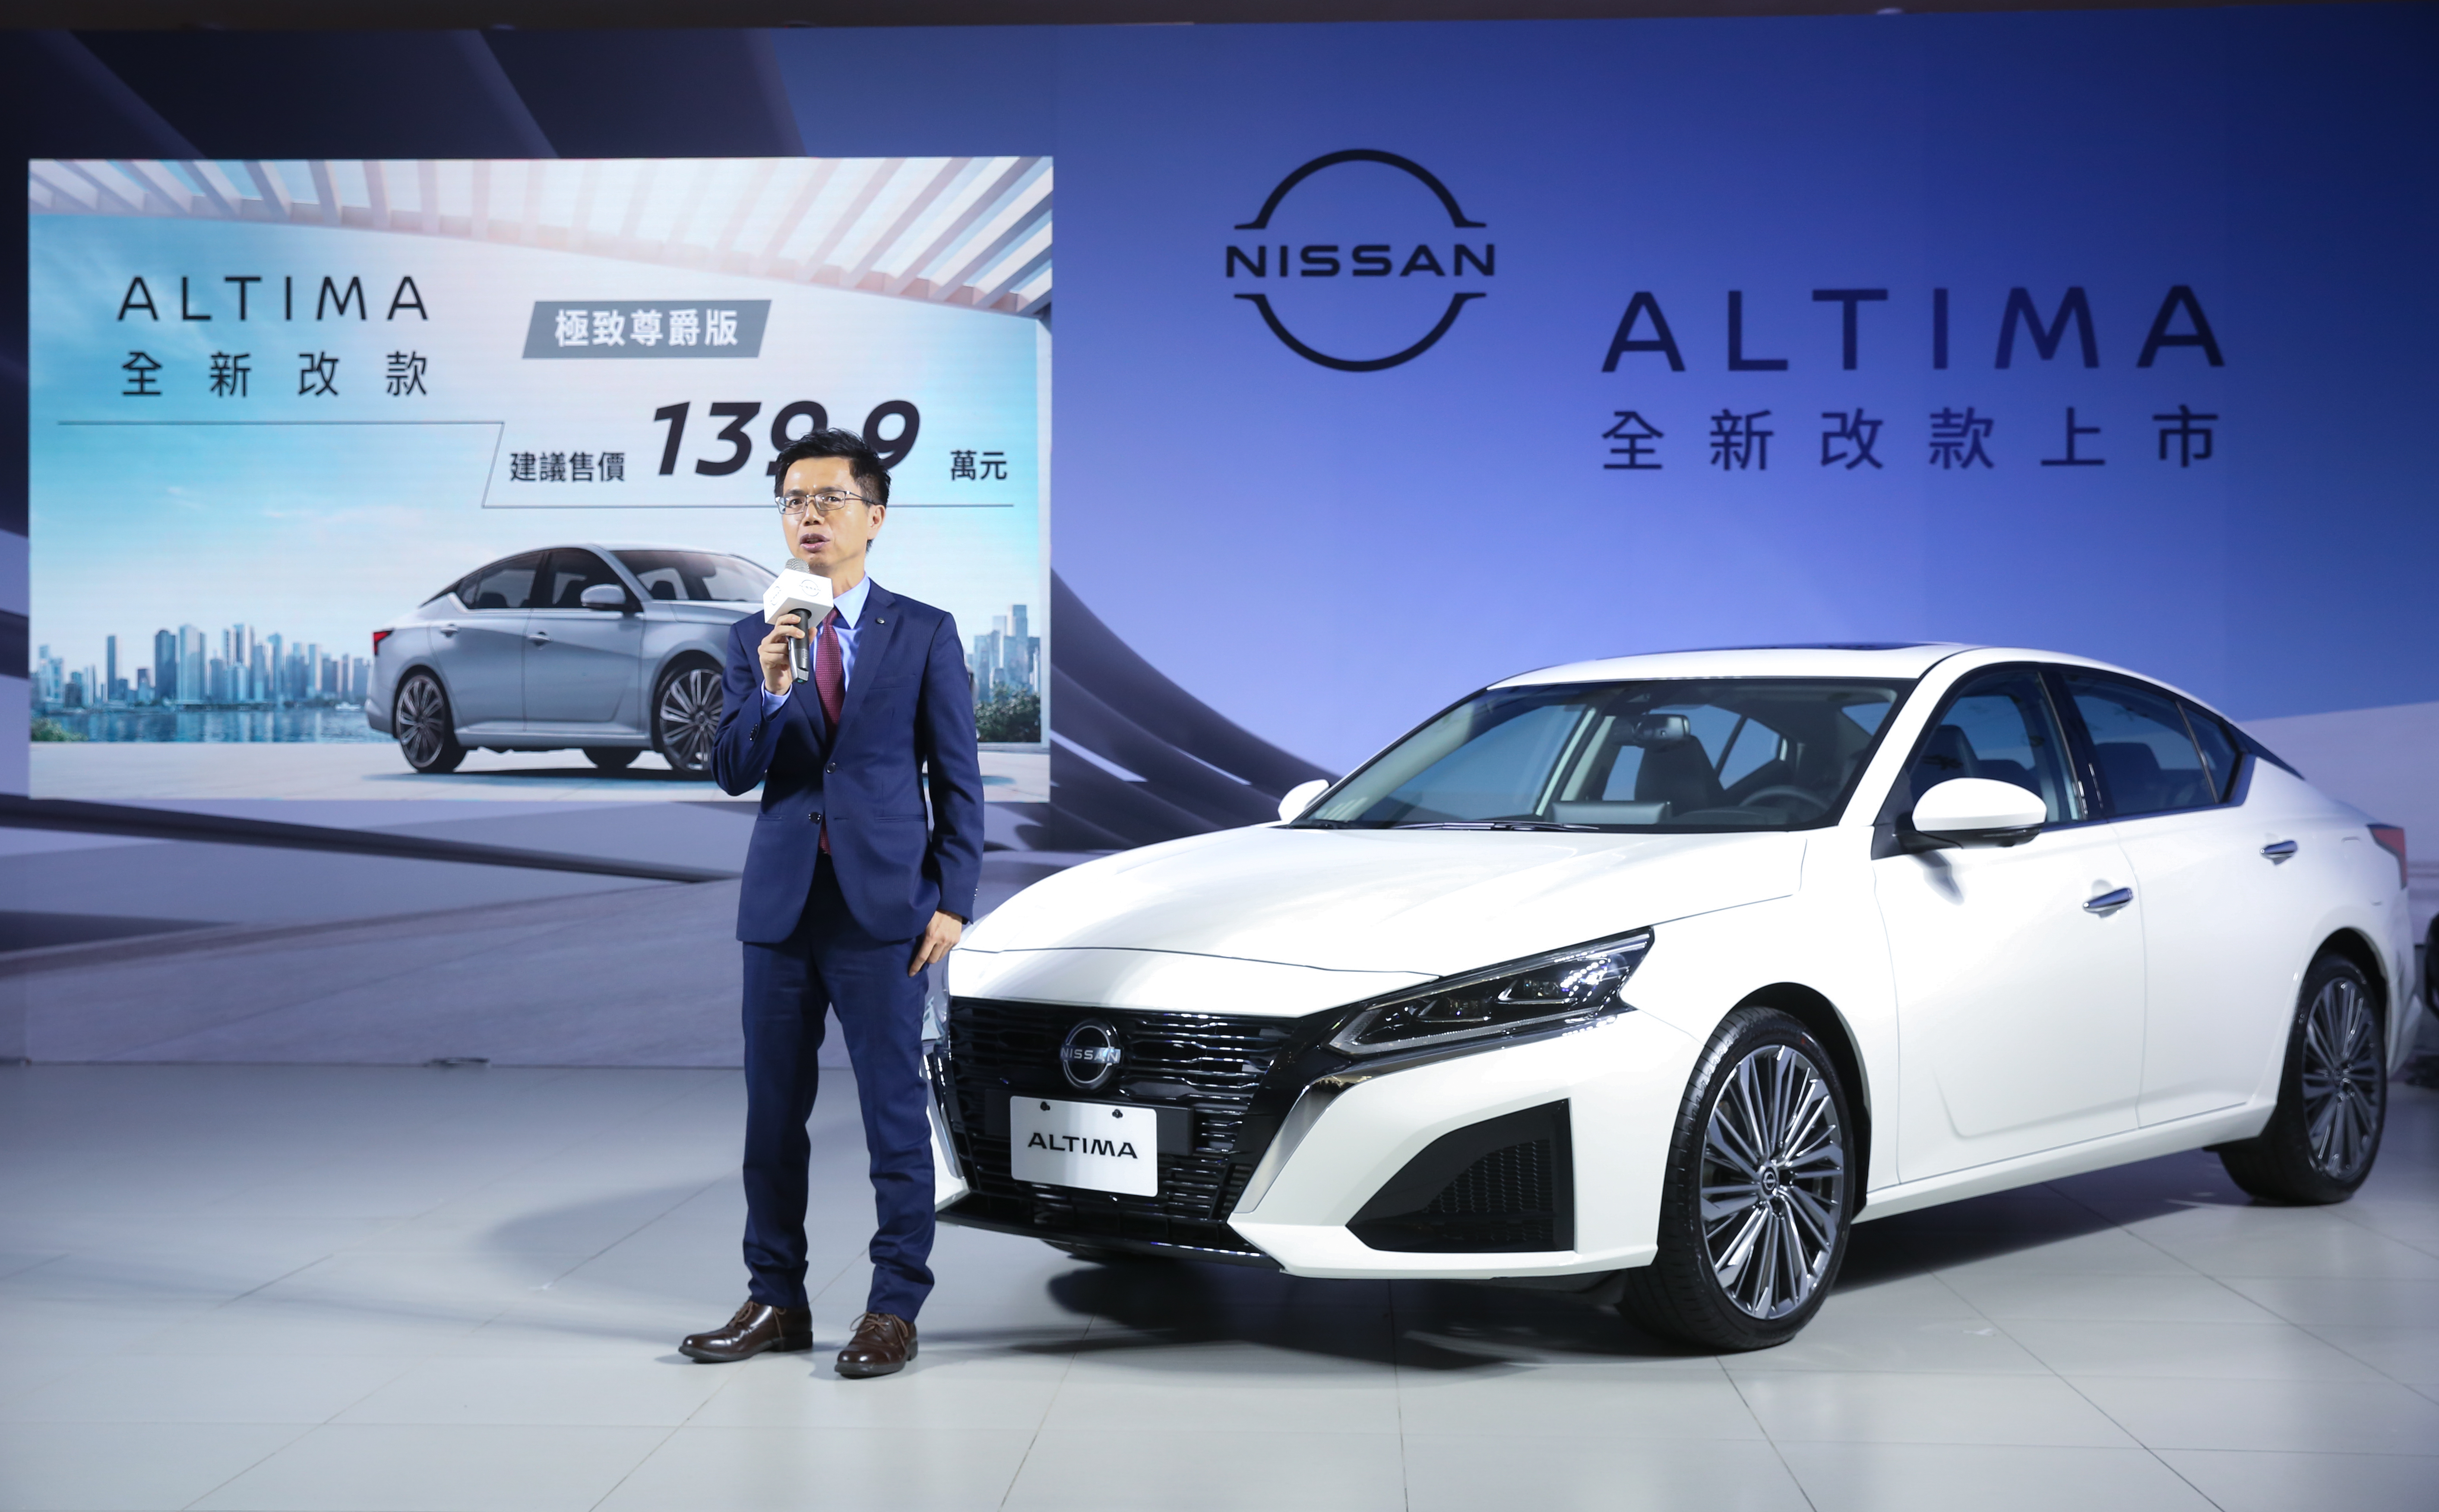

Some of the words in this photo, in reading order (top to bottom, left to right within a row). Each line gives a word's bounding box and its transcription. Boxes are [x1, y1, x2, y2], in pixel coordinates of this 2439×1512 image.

[1225, 243, 1496, 278] NISSAN
[118, 276, 428, 322] ALTIMA
[555, 309, 738, 347] 極致尊爵版
[1601, 285, 2224, 373] ALTIMA
[123, 350, 428, 398] 全新改款
[1601, 404, 2218, 471] 全新改款上市
[510, 451, 624, 482] 建議售價
[950, 450, 1007, 480] 萬元
[1060, 1048, 1118, 1062] NISSAN
[1028, 1132, 1138, 1159] ALTIMA
